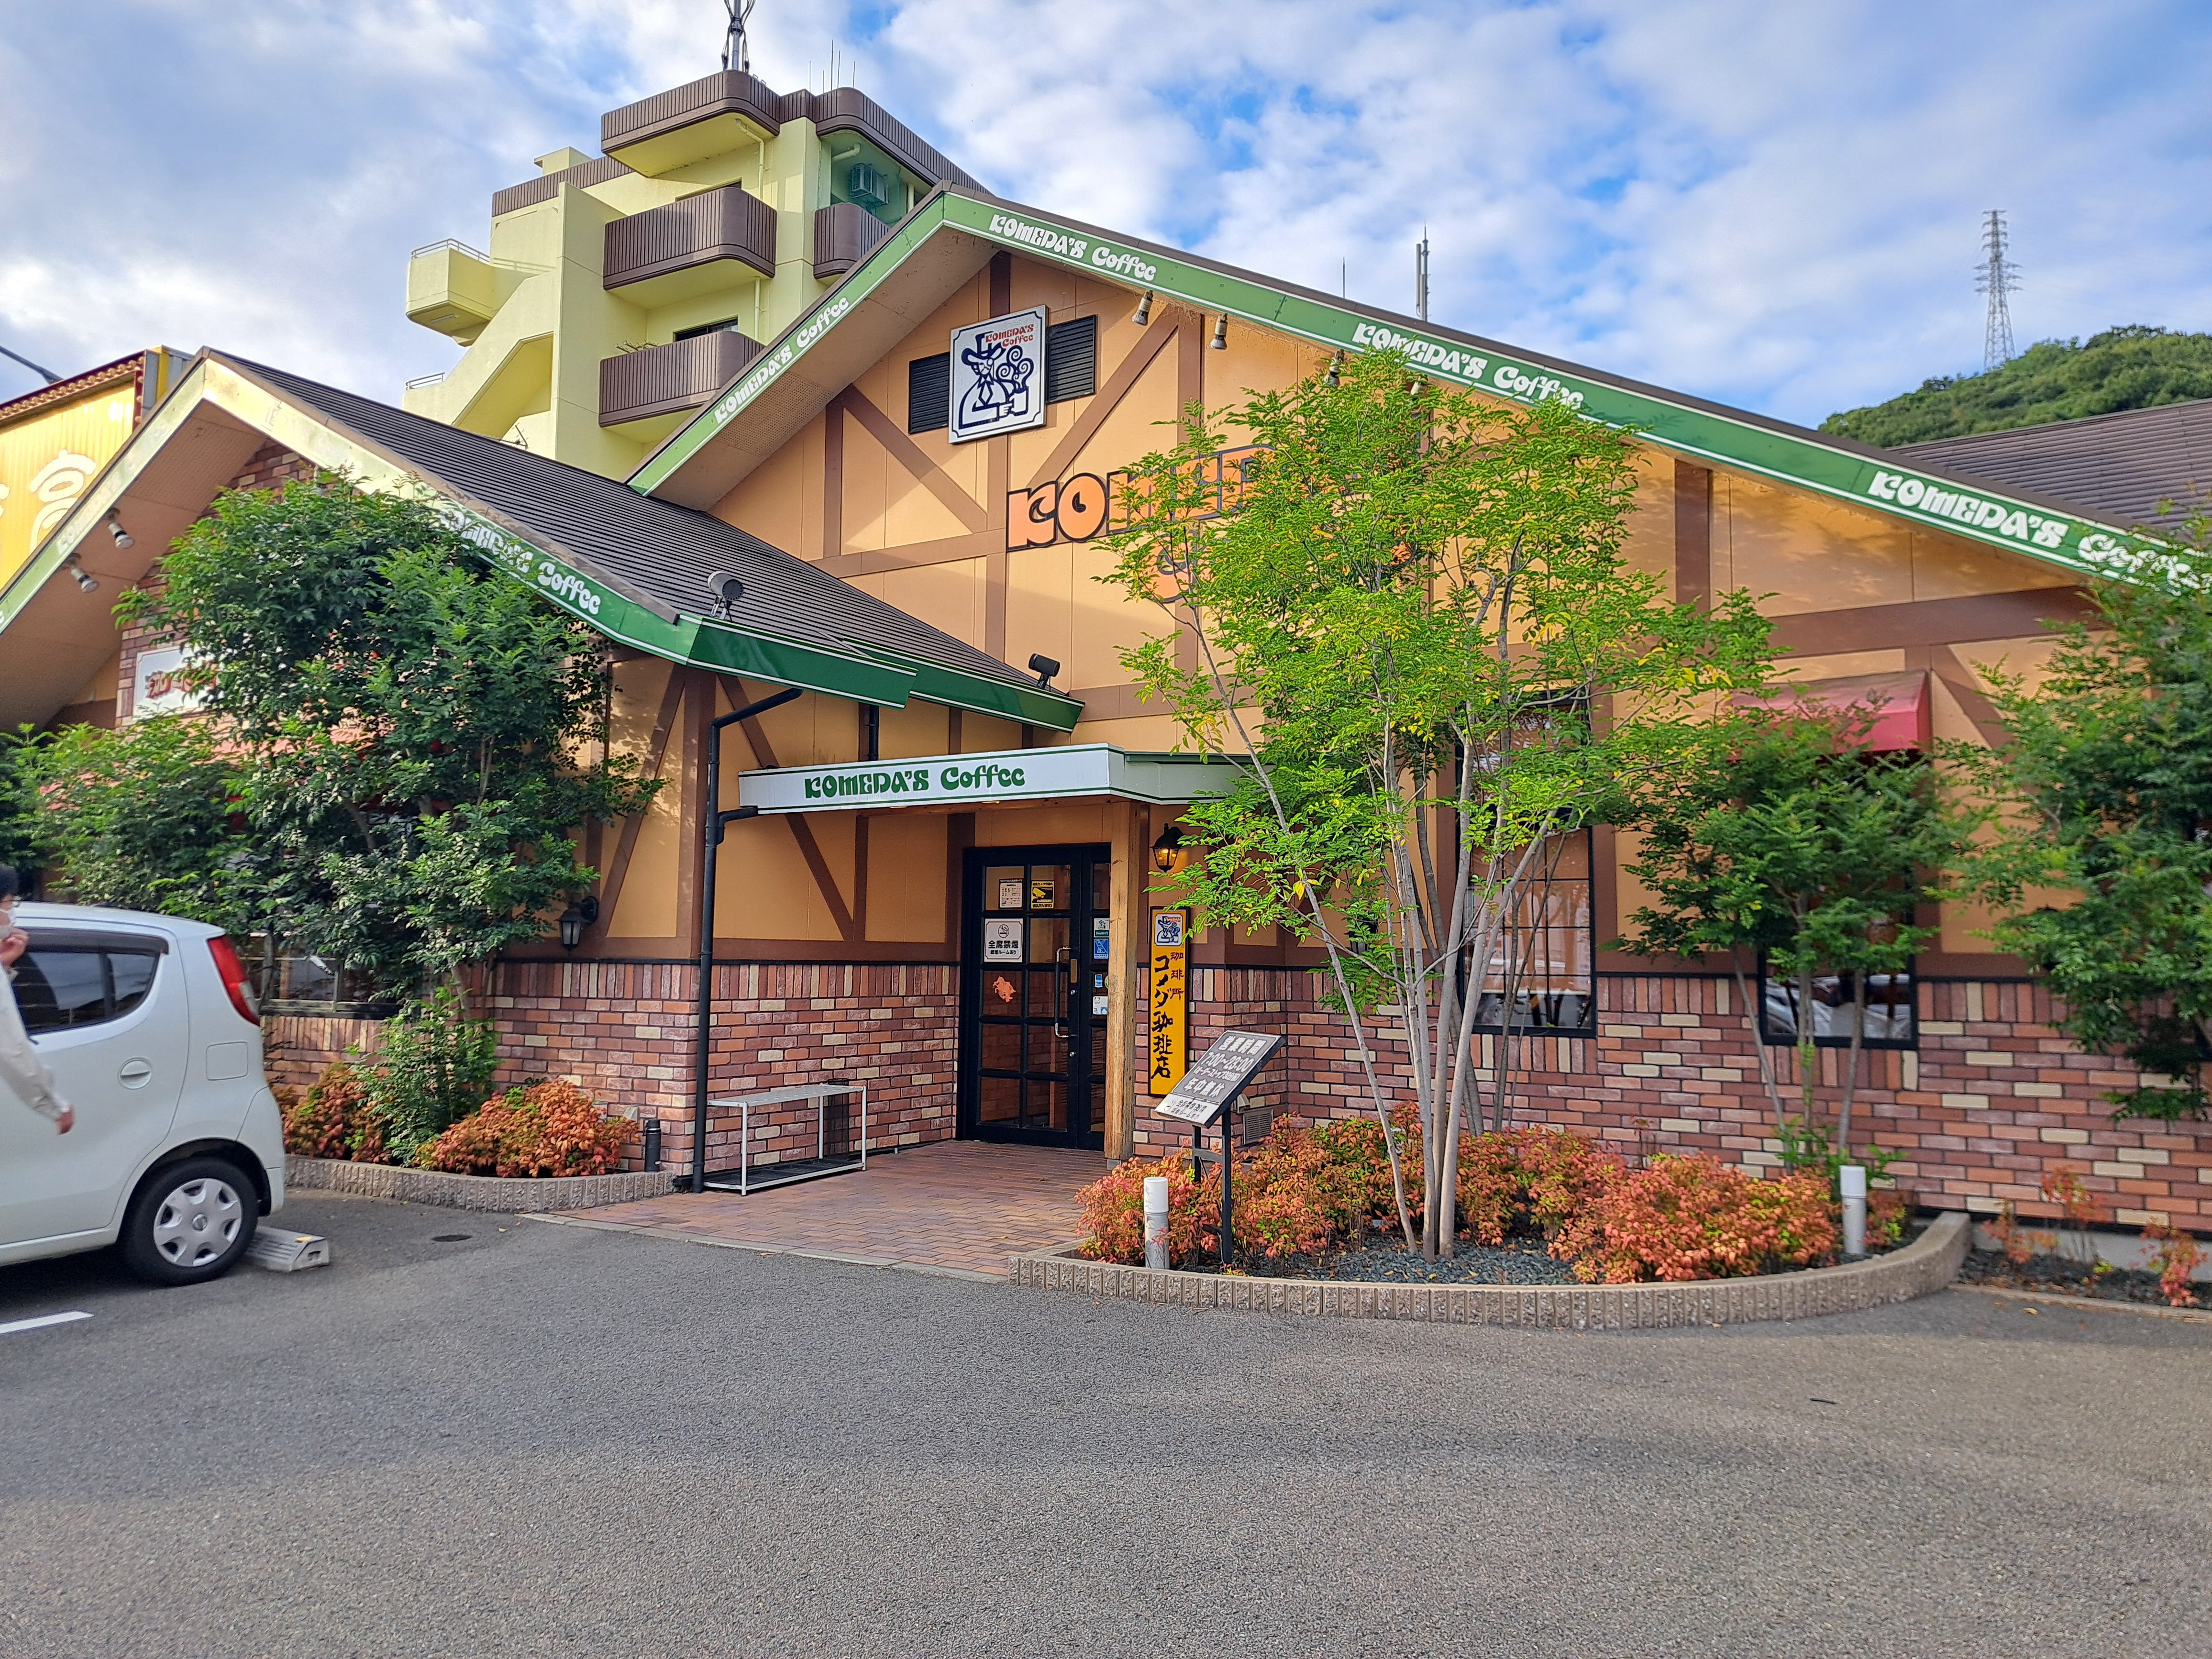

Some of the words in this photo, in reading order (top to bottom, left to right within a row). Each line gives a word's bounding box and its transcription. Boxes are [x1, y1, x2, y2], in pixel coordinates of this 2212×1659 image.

[989, 214, 1088, 259] KOMEDA'S
[1091, 247, 1157, 281] Coffee
[985, 324, 1034, 343] KOMEDA'S
[1002, 333, 1034, 347] Coffee
[1352, 322, 1488, 379] KOMEDA'S
[713, 344, 793, 424] KOMEDA'S
[796, 297, 850, 348] Coffee
[1868, 470, 2069, 549] KOMEDA'S
[538, 562, 601, 615] Coffee
[805, 768, 929, 799] KOMEDA'S
[940, 764, 1025, 791] Coffee
[988, 940, 1018, 949] 全席禁煙
[1218, 1035, 1267, 1055] 営業時間
[1183, 1077, 1226, 1097] 年中無休
